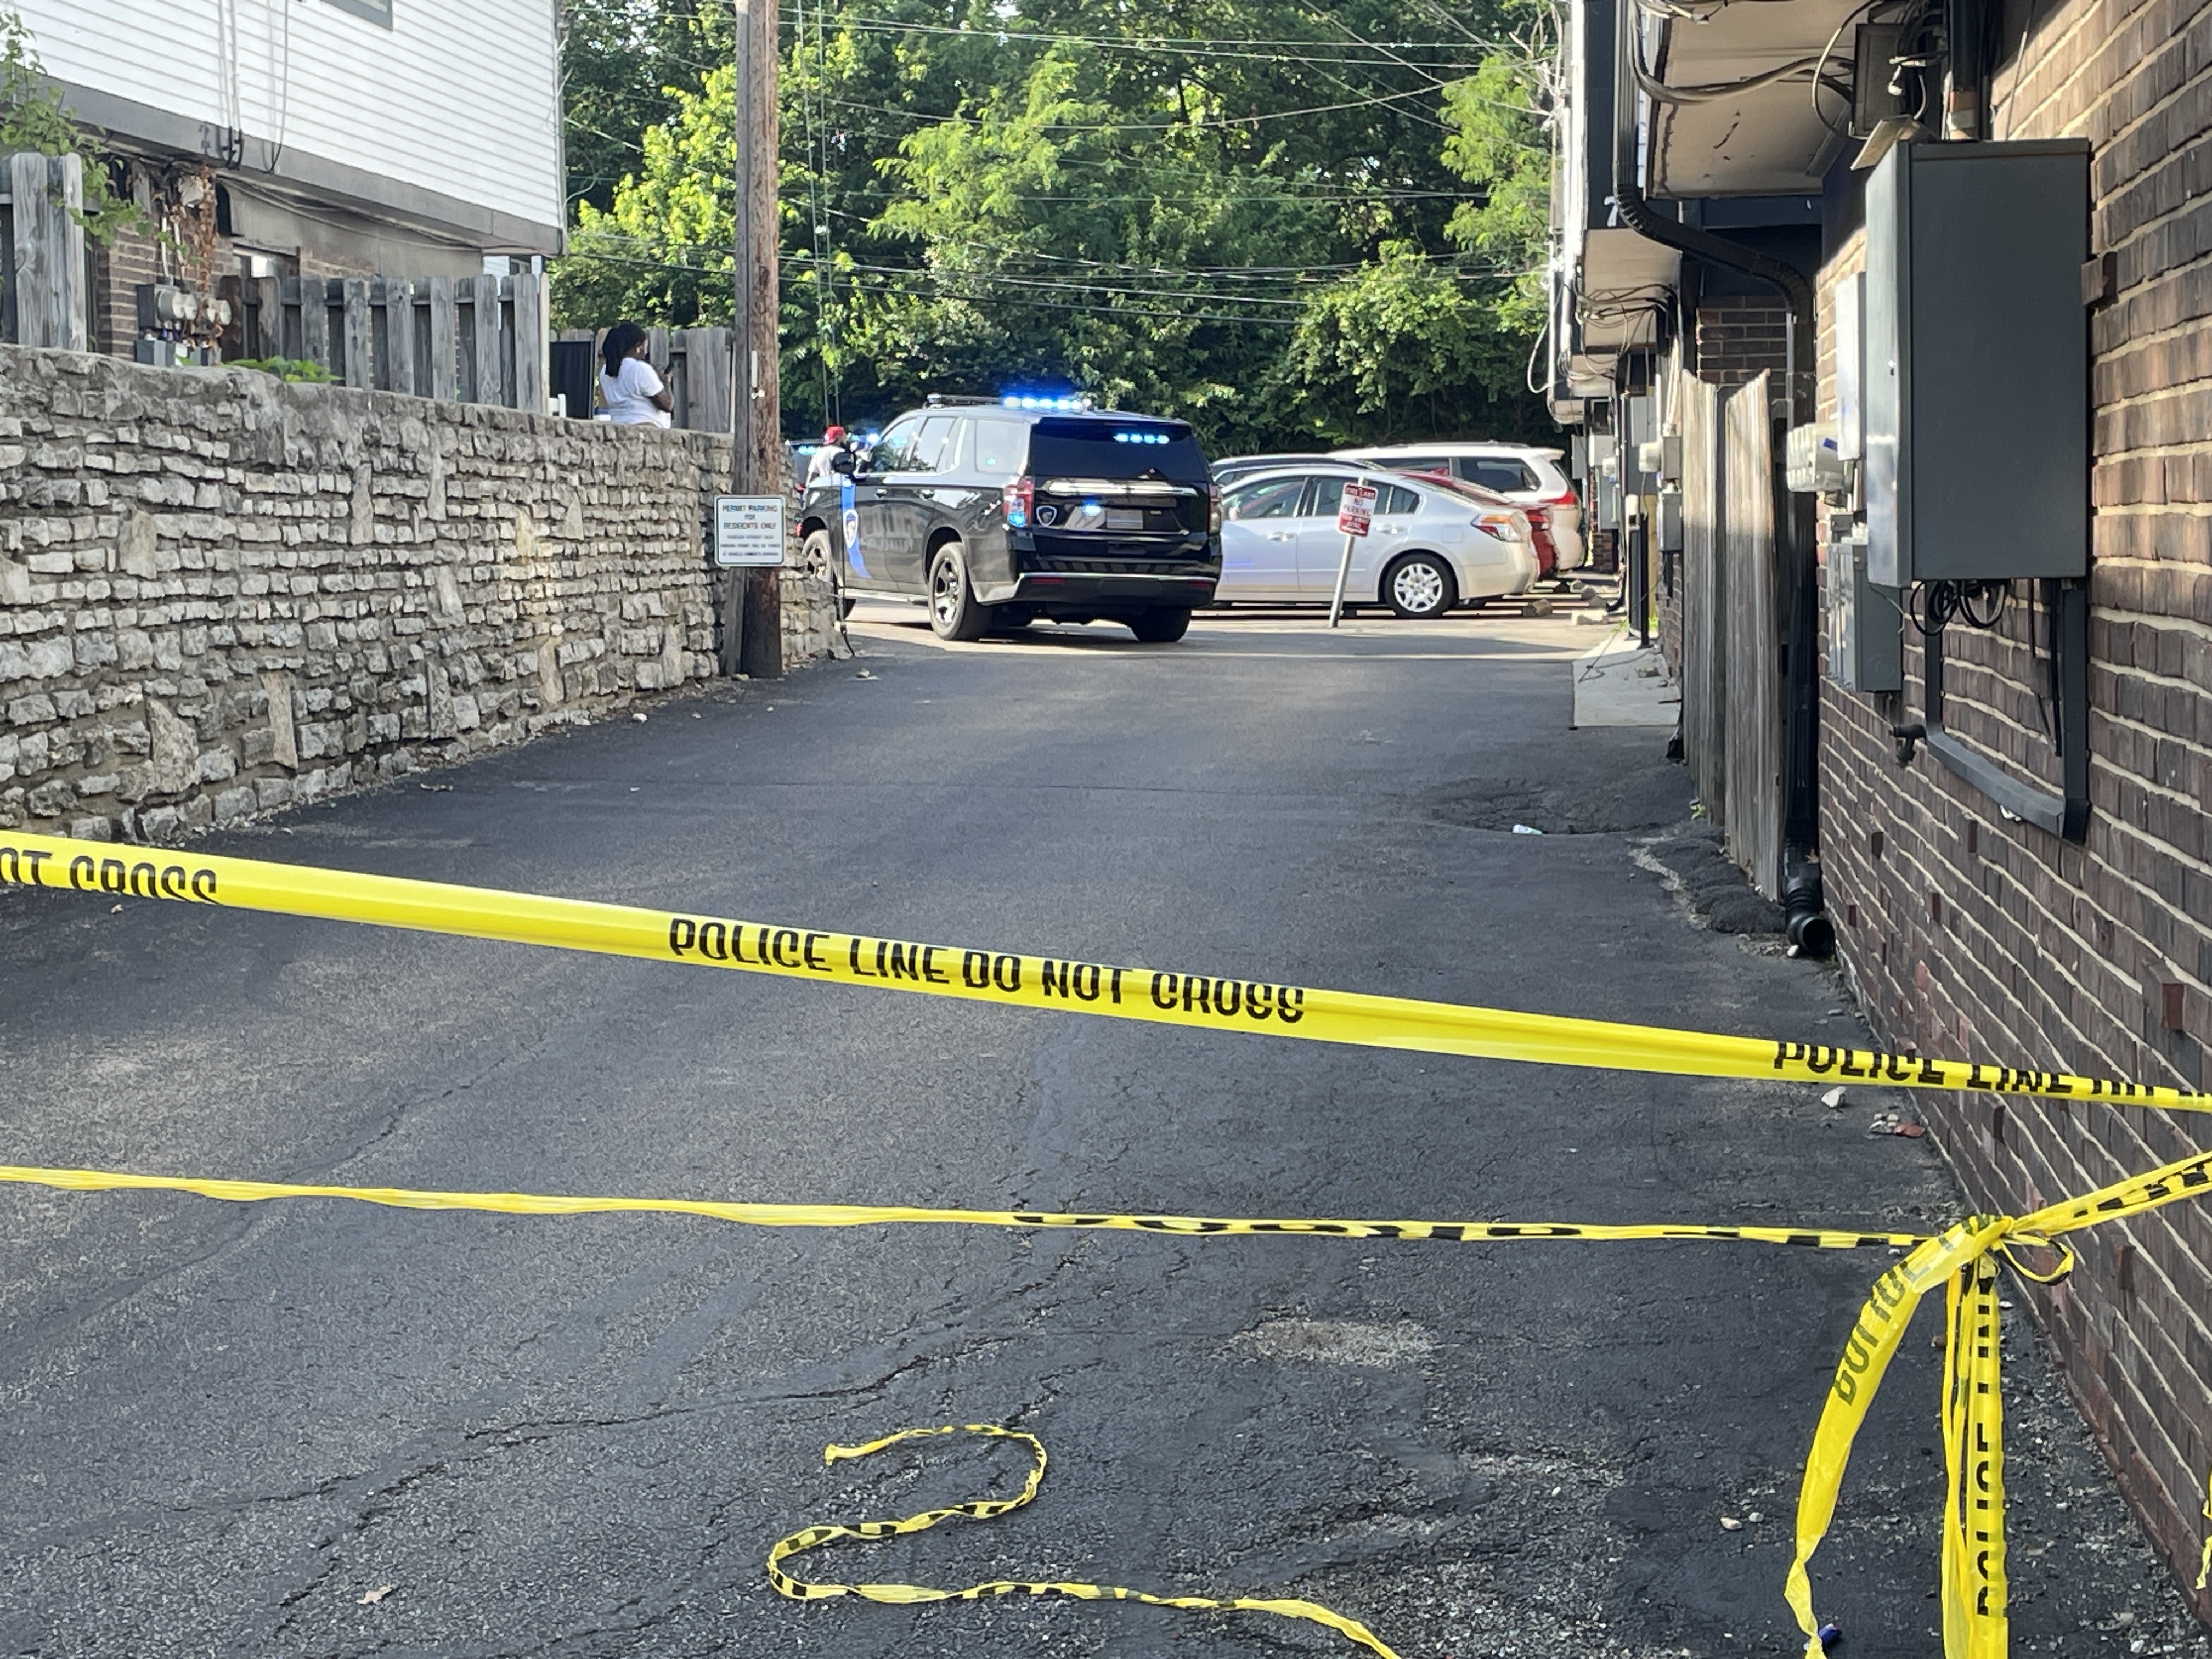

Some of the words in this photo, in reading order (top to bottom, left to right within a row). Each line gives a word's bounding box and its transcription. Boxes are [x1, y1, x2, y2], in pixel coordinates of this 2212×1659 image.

[669, 918, 833, 972] POLICE
[849, 938, 950, 984] LINE
[963, 950, 1021, 992] DO
[1042, 959, 1133, 1004] NOT
[1151, 970, 1304, 1023] CROSS
